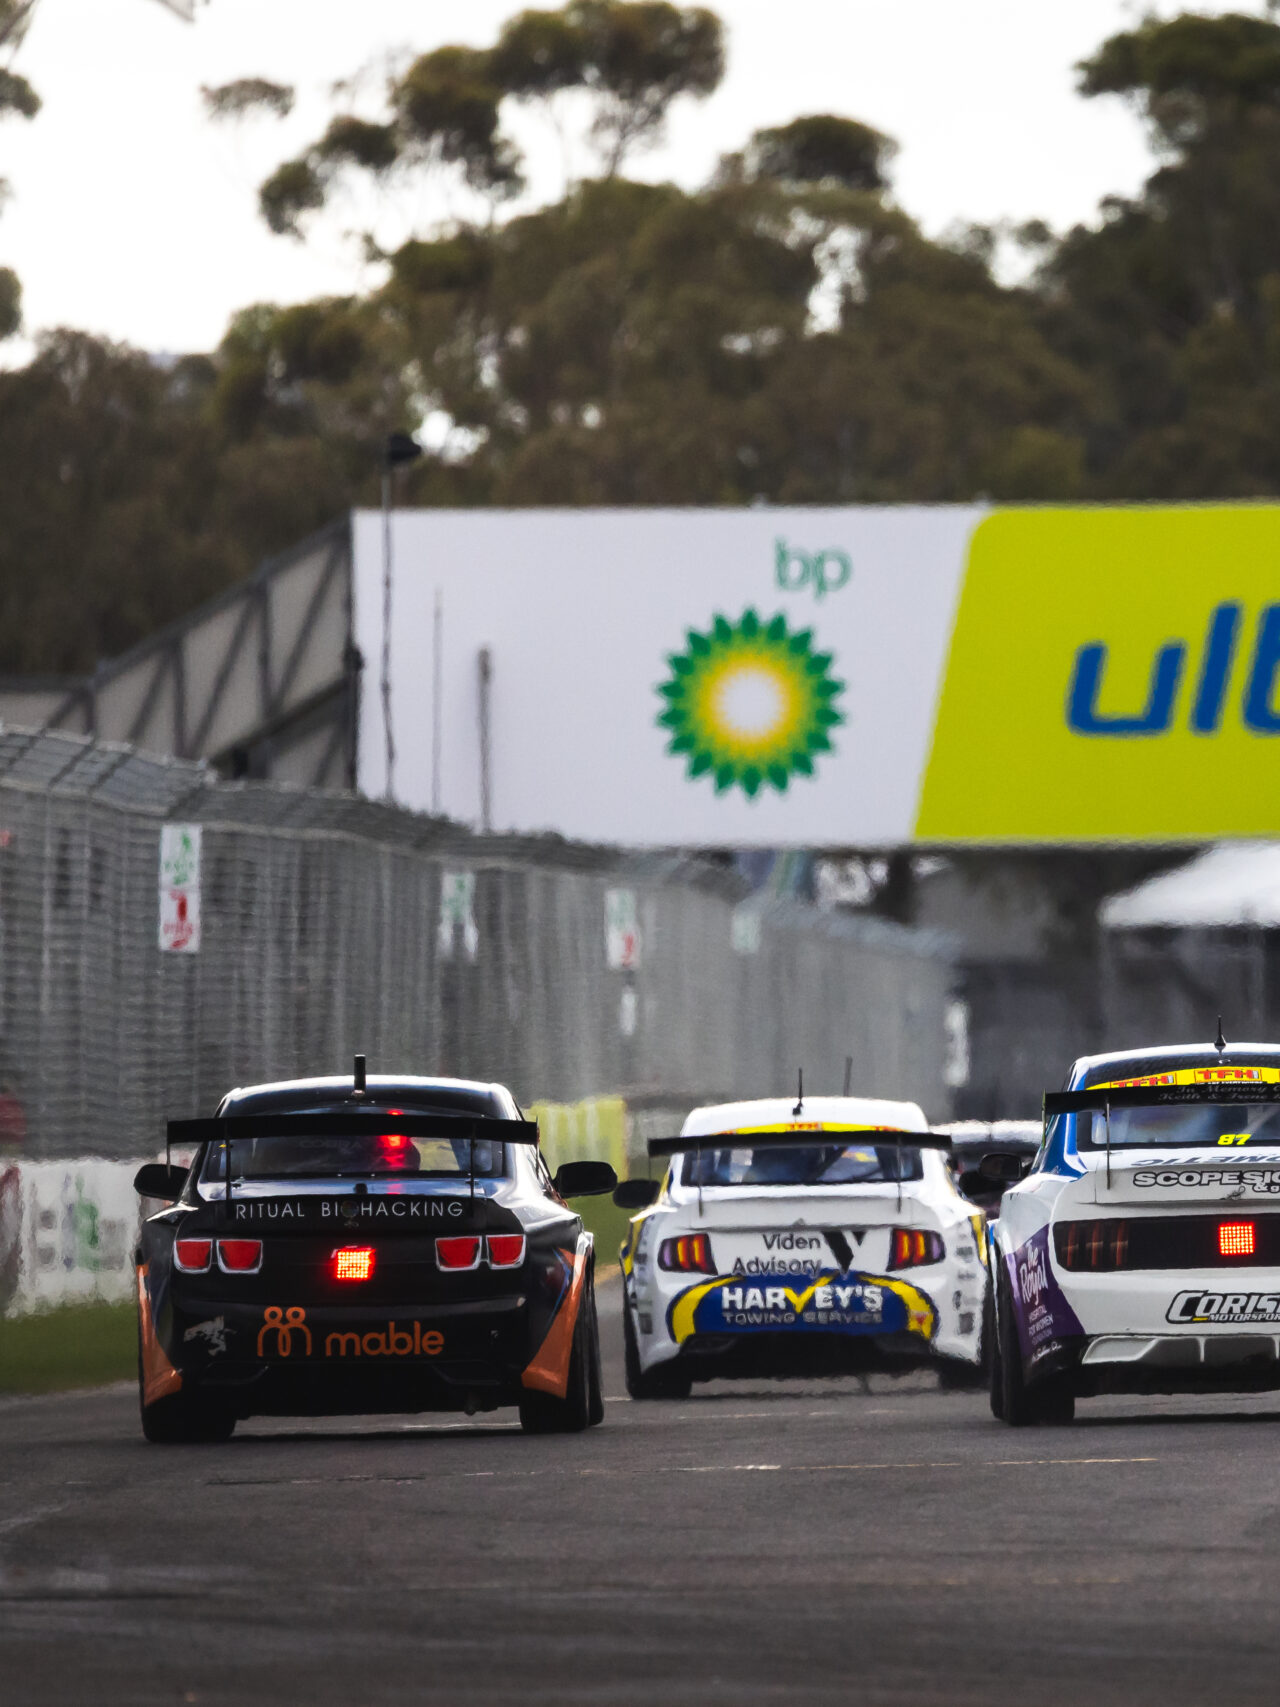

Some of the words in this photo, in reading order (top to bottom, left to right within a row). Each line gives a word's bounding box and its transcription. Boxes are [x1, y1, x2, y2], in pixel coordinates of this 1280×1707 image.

[773, 534, 853, 604] bp
[1198, 1069, 1254, 1080] TFH
[1217, 1134, 1251, 1145] 87
[236, 1202, 305, 1220] RITUAL
[762, 1232, 821, 1251] Viden
[732, 1256, 822, 1278] Advisory
[1020, 1250, 1048, 1306] Royal
[721, 1286, 883, 1313] HARVEY'S
[722, 1312, 796, 1325] TOWING
[803, 1312, 883, 1325] SERVICE
[325, 1320, 445, 1357] mable
